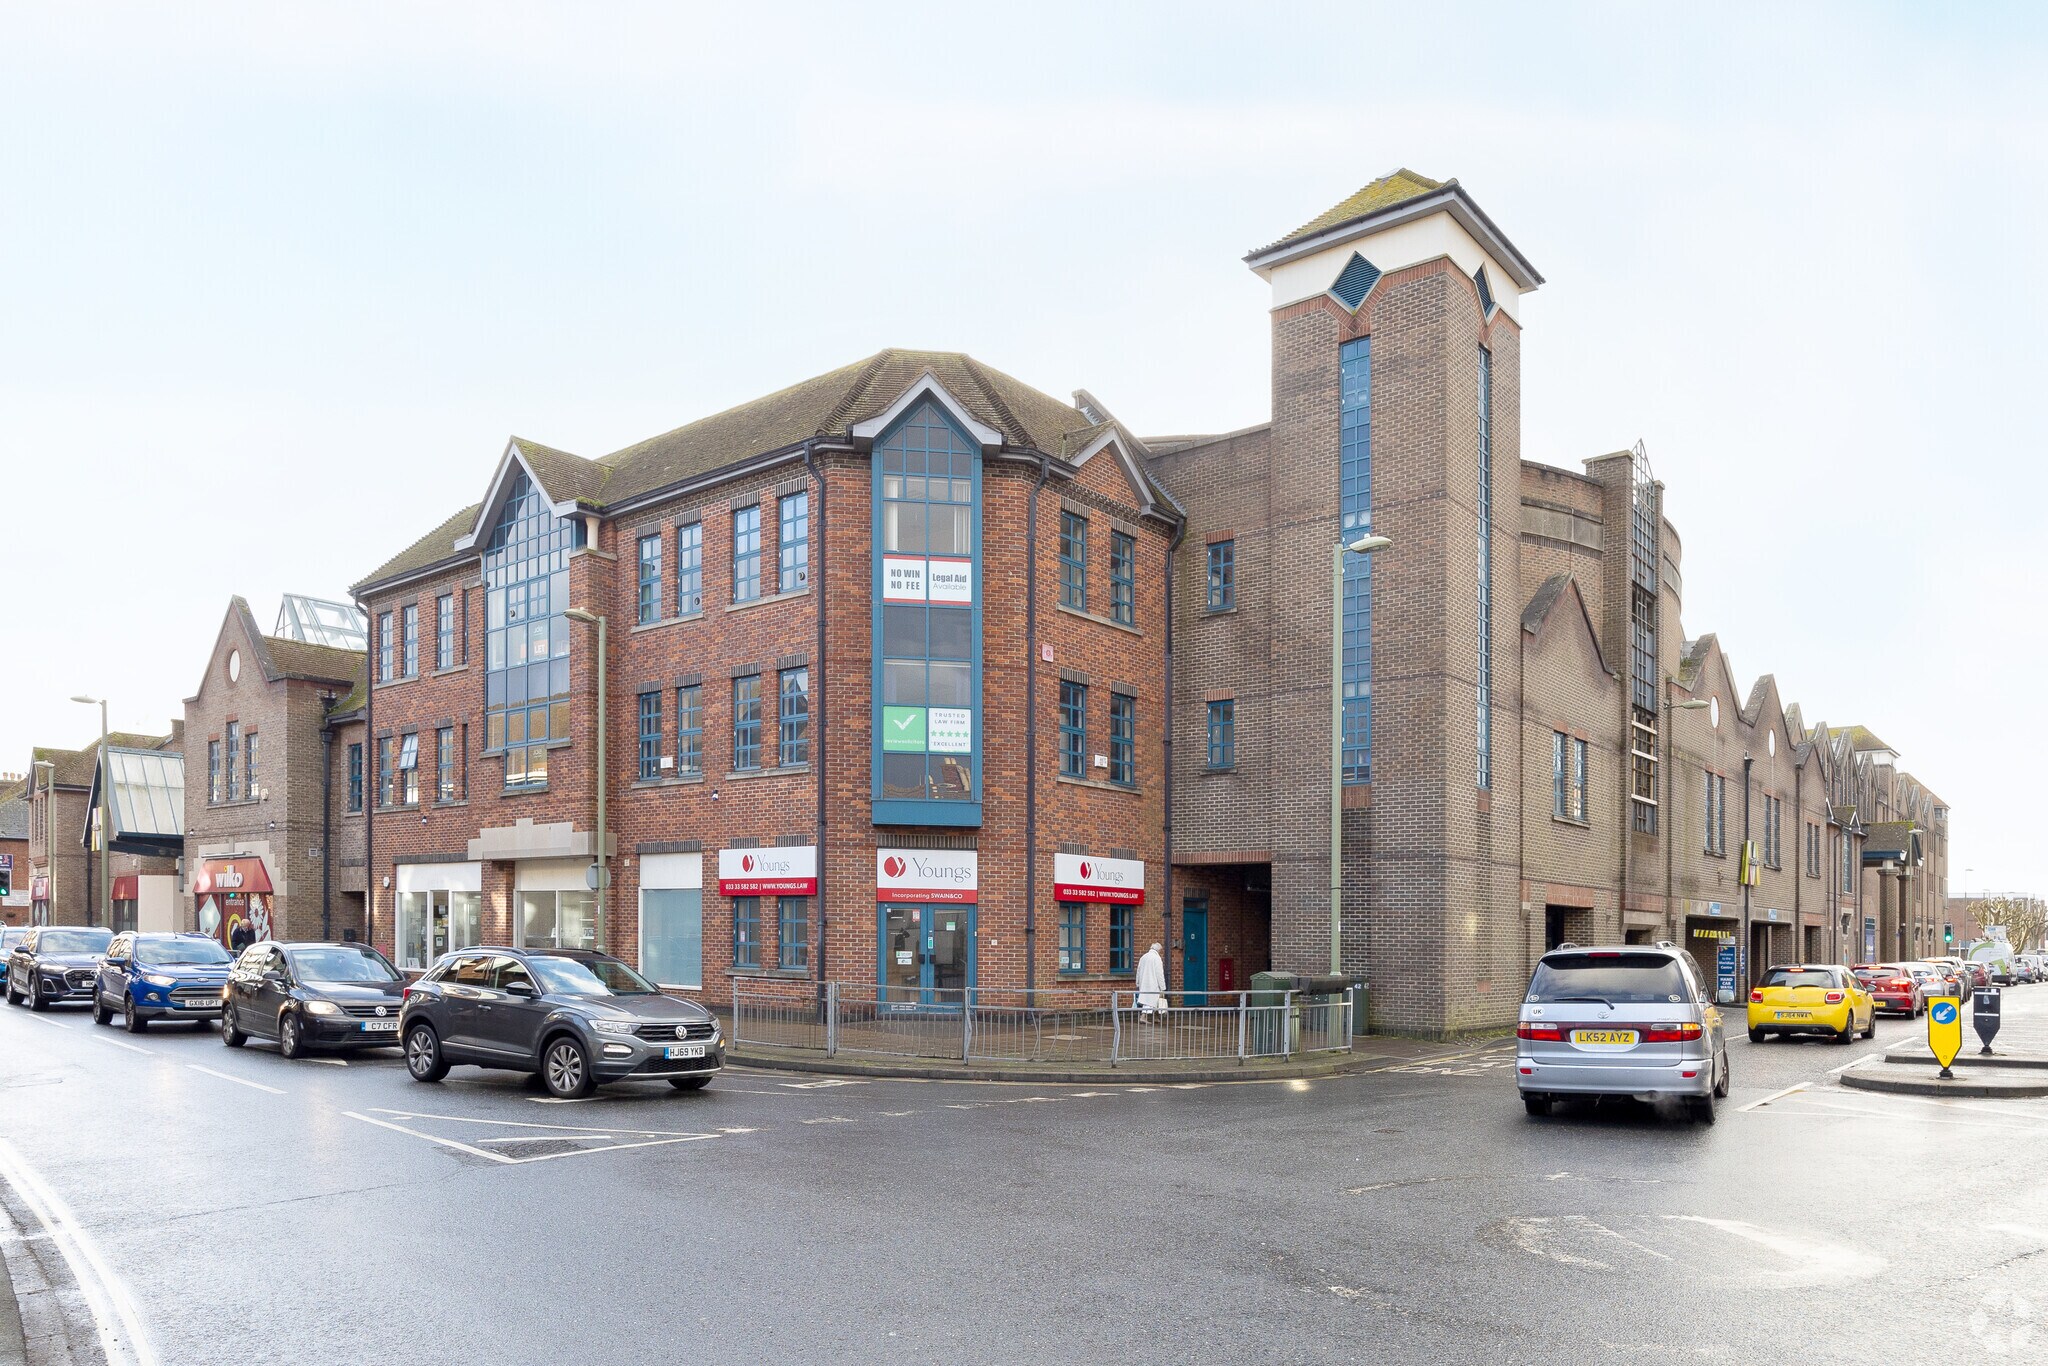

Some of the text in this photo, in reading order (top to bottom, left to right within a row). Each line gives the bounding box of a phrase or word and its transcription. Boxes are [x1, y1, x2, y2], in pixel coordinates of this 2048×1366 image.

[890, 569, 920, 579] NO WIN
[932, 573, 967, 583] Legal Aid
[890, 581, 920, 590] NO FEE
[932, 583, 967, 591] Available
[756, 854, 791, 875] Youngs
[912, 857, 972, 883] Youngs
[1094, 862, 1124, 885] Youngs
[215, 864, 245, 888] wilko
[762, 882, 809, 890] WWW.YOUNGS.LAW
[371, 1022, 398, 1030] C7 CFR
[1579, 1032, 1630, 1042] LK52 AYZ
[669, 1047, 704, 1057] HJ69 YKB
